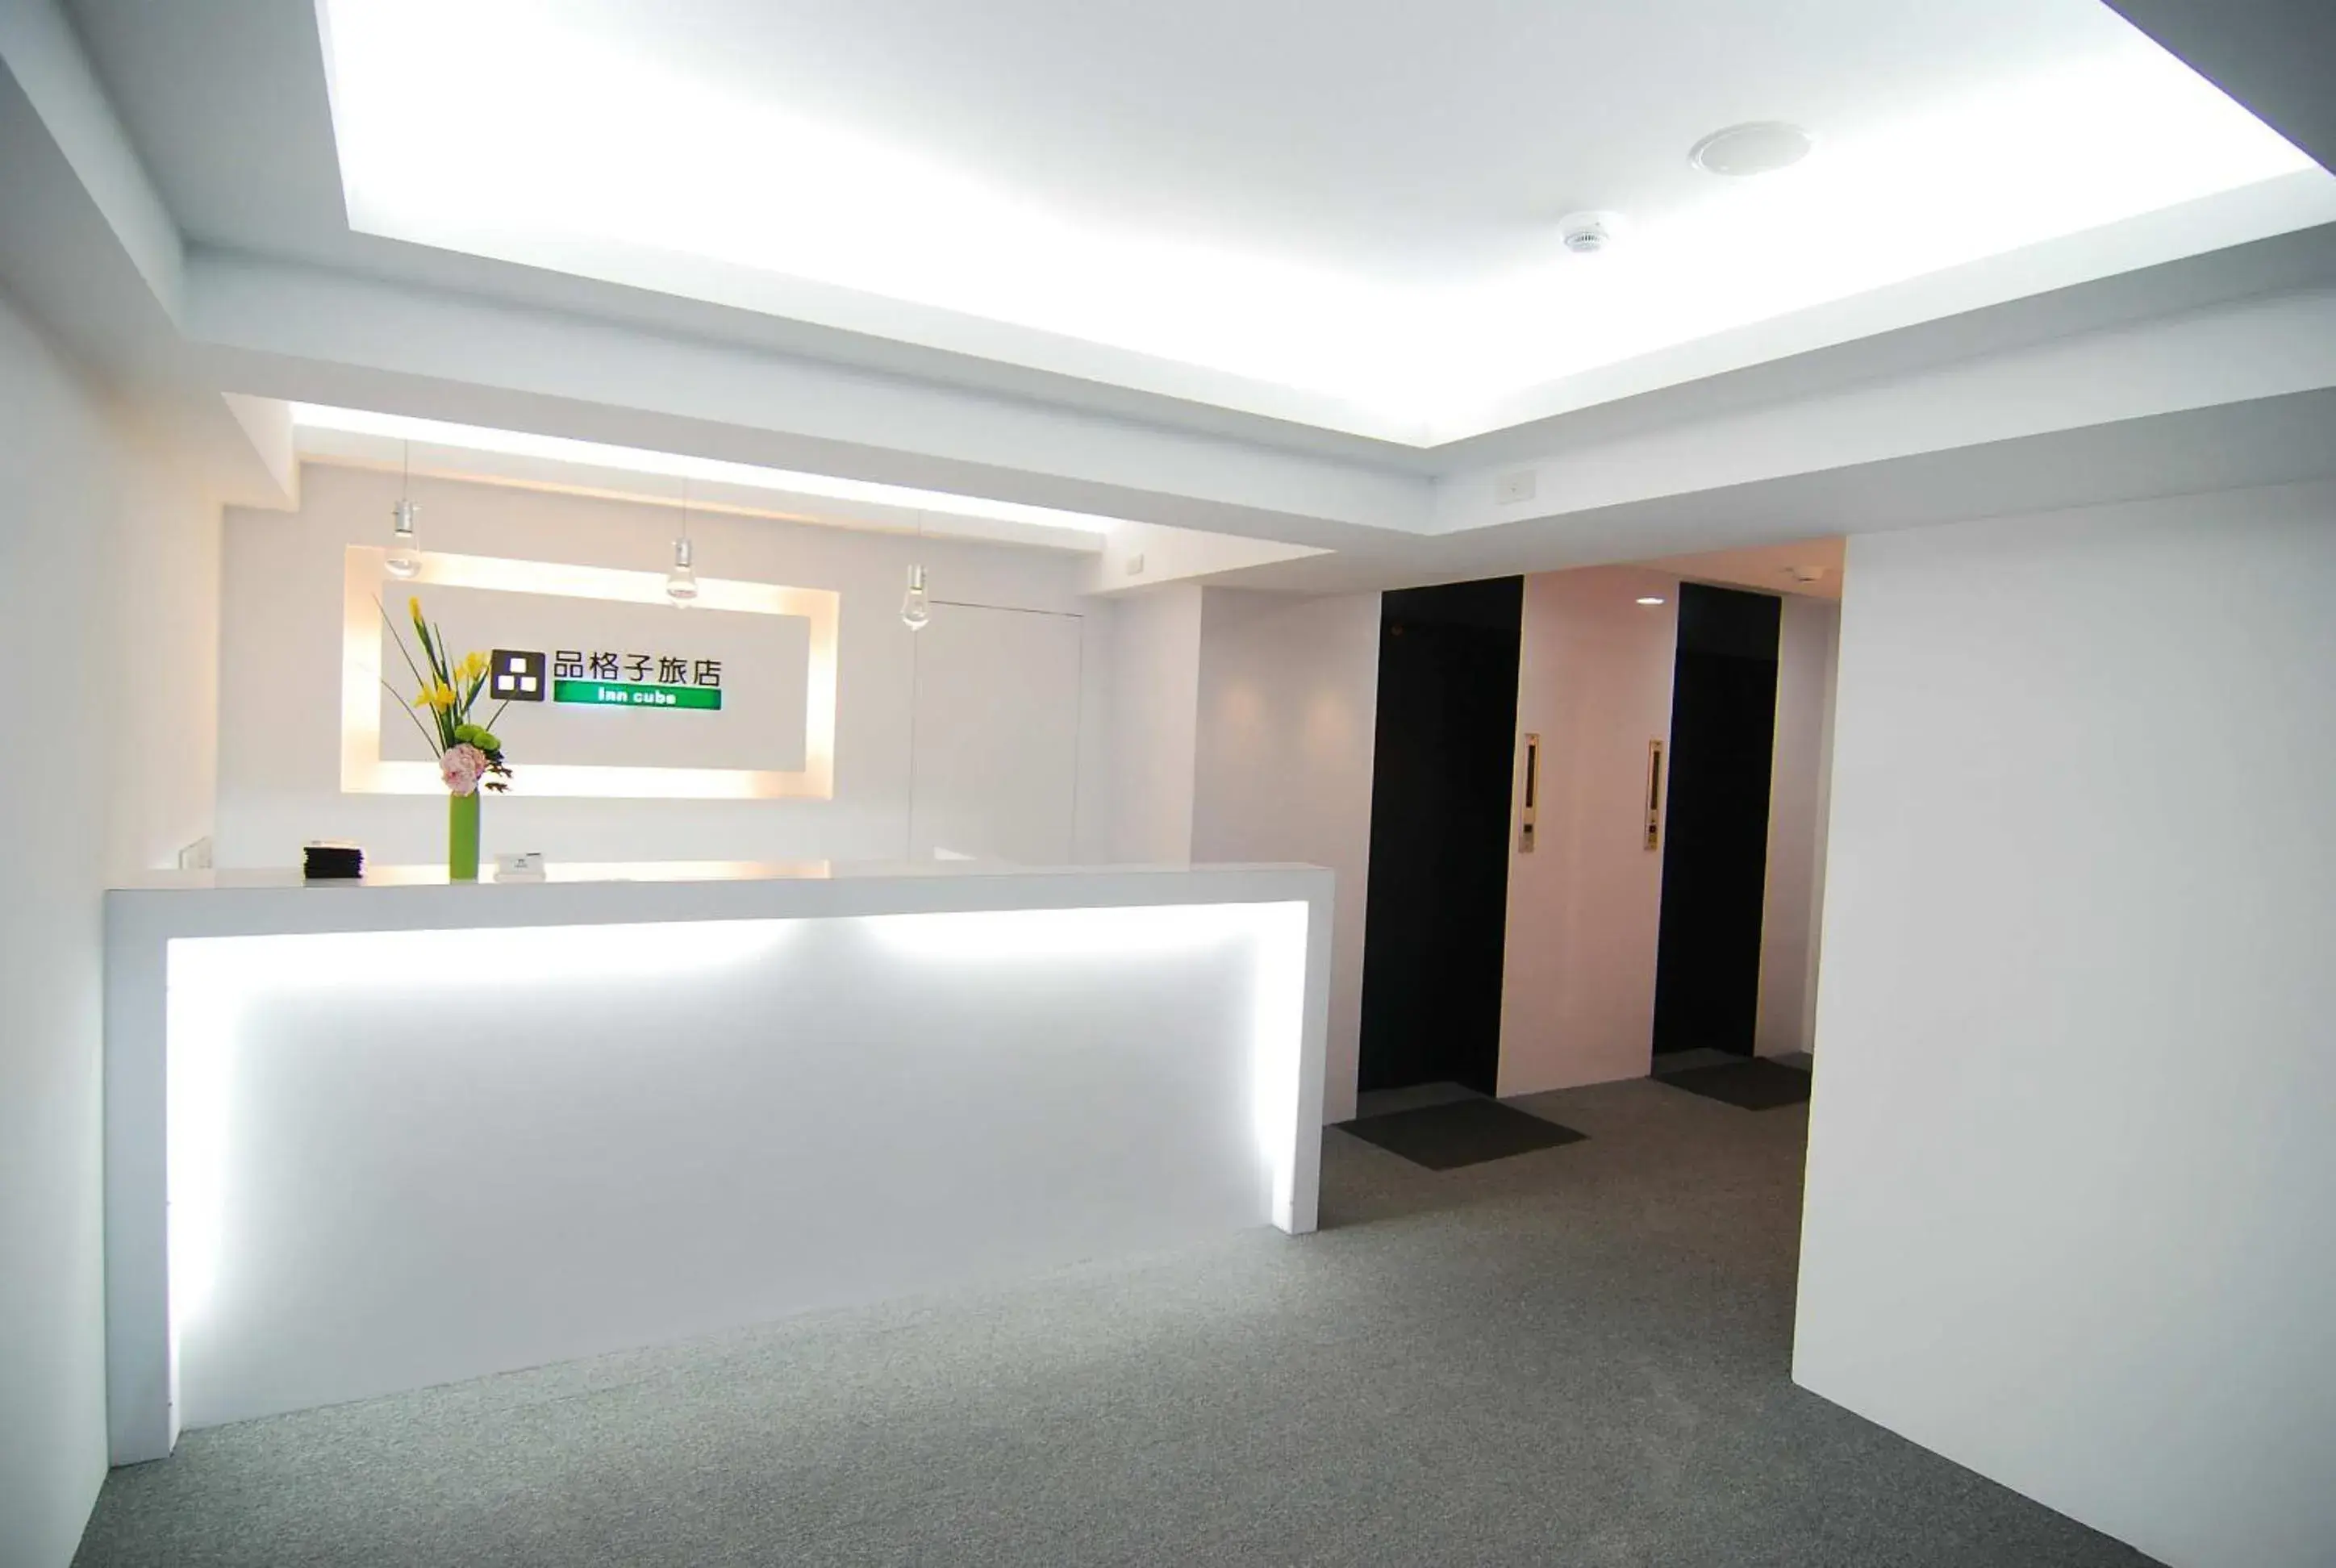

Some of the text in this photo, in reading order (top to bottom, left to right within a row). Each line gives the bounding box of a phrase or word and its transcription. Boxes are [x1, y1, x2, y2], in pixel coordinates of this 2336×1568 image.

[554, 650, 722, 686] 品格子旅店
[598, 686, 676, 704] Inn cube
